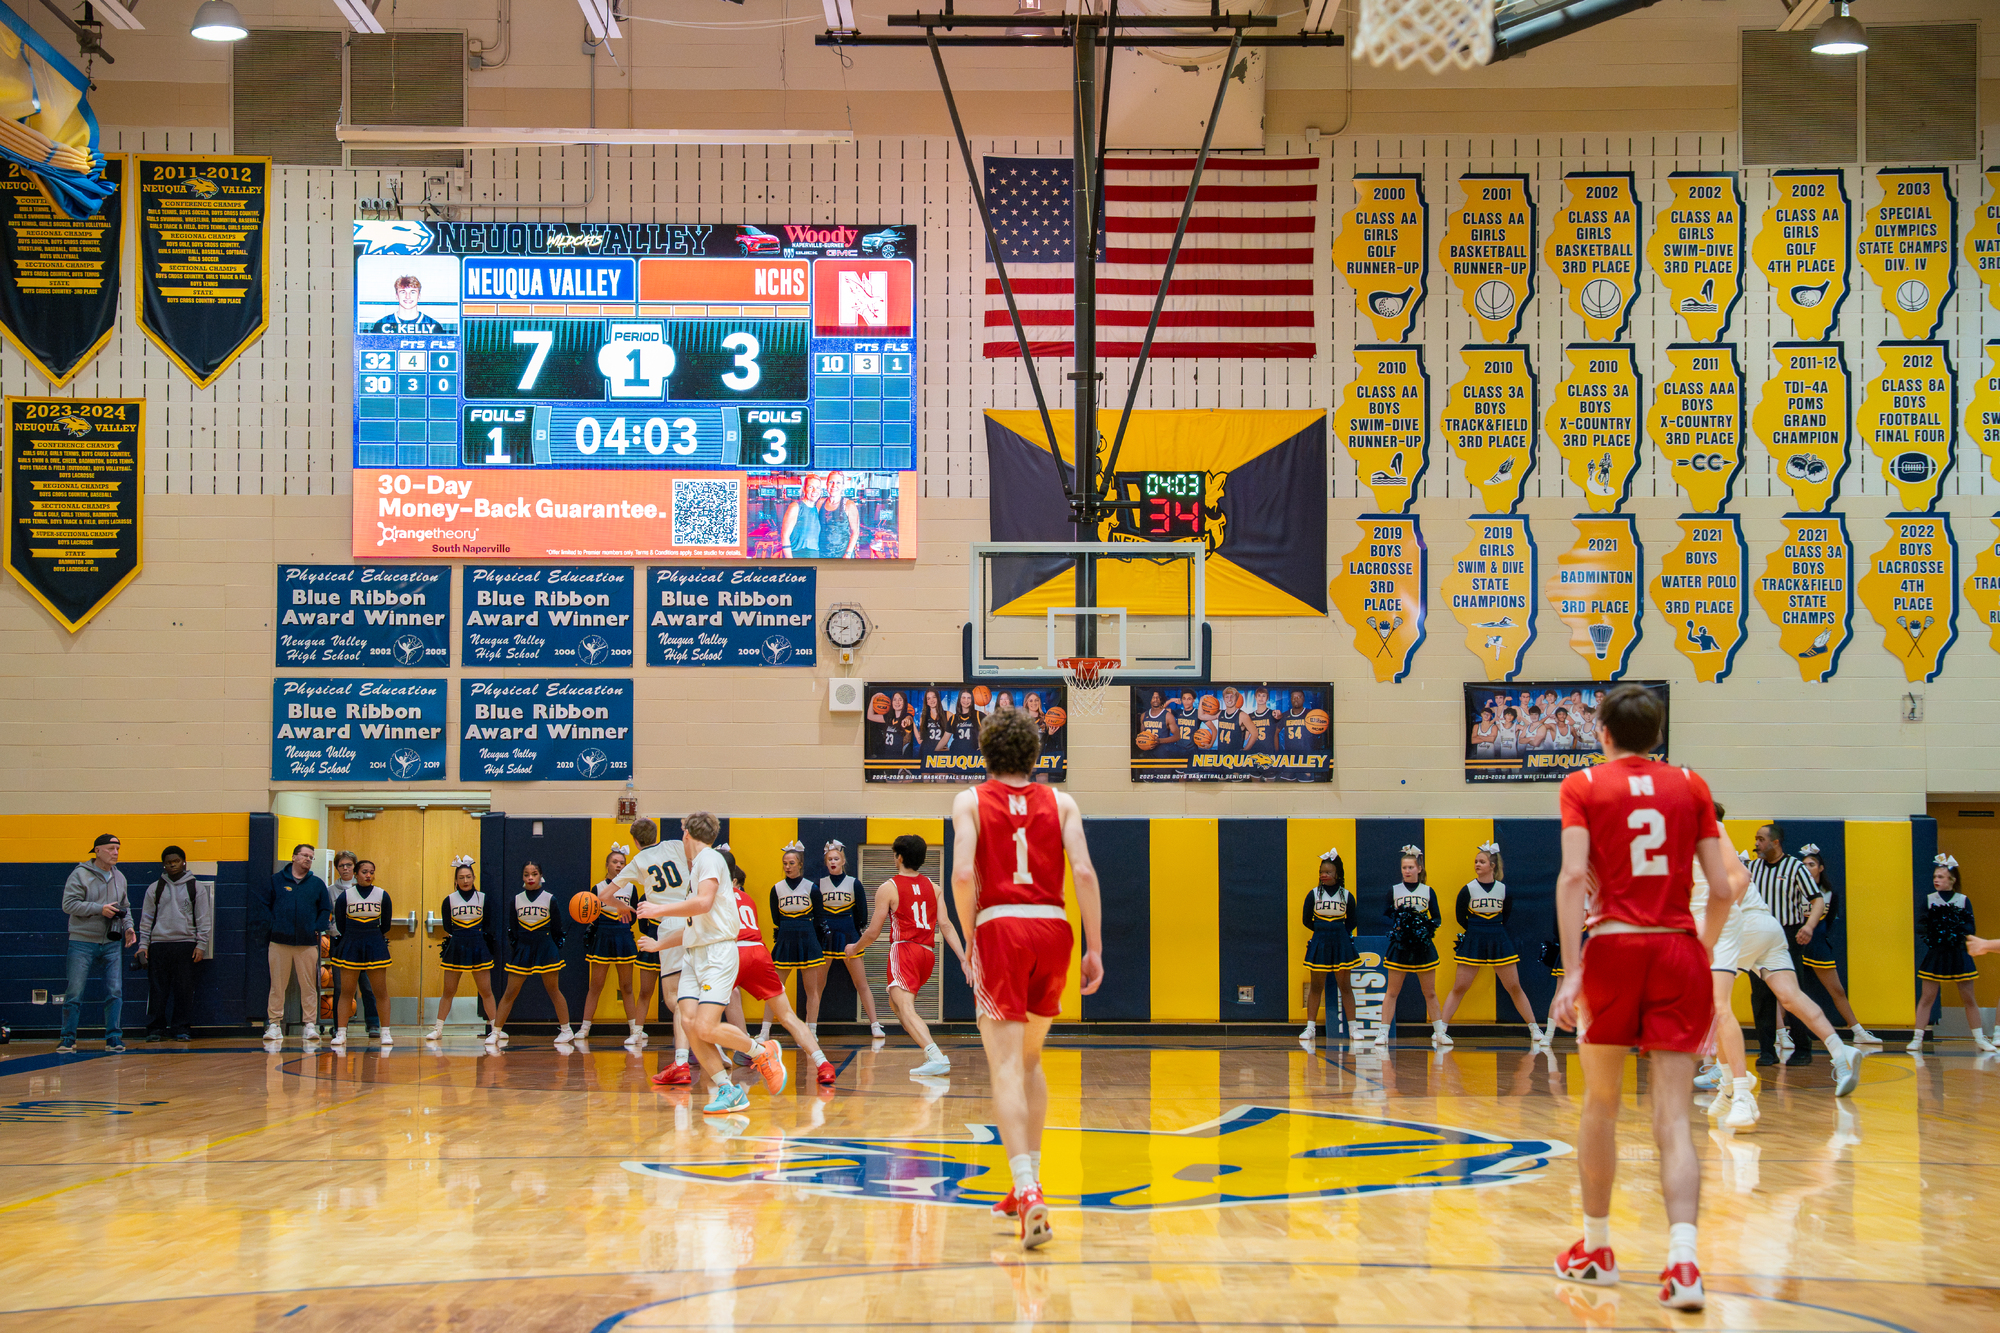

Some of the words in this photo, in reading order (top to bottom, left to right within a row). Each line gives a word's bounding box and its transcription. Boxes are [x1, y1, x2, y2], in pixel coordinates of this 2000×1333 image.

[154, 166, 251, 182] 2011-2012
[143, 185, 187, 194] NEUQUA
[221, 186, 262, 194] VALLEY
[1373, 188, 1405, 200] 2000
[1897, 182, 1930, 195] 2003
[1356, 212, 1395, 225] CLASS
[1401, 212, 1417, 225] AA
[1880, 207, 1932, 220] SPECIAL
[784, 225, 858, 247] Woody
[1364, 228, 1398, 241] GIRLS
[1875, 224, 1937, 237] OLYMPICS
[438, 223, 576, 255] NEUQUA
[580, 223, 712, 255] VALLEY
[547, 233, 603, 247] WILDCATS
[1367, 245, 1396, 258] GOLF
[1859, 241, 1894, 254] STATE
[1899, 240, 1947, 254] CHAMPS
[1347, 261, 1419, 274] RUNNER-UP
[1885, 258, 1909, 271] DIV.
[1915, 258, 1927, 271] IV
[468, 268, 543, 299] NEUQUA
[548, 269, 621, 296] VALLEY
[755, 268, 804, 295] NCHS
[398, 324, 435, 333] KELLY
[615, 332, 659, 341] PERIOD
[400, 341, 425, 350] PTS
[431, 341, 455, 350] FLS
[855, 343, 879, 351] PTS
[884, 343, 909, 351] FLS
[365, 353, 391, 369] 32
[408, 355, 417, 367] 4
[439, 355, 448, 367] 0
[513, 331, 553, 390] 7
[721, 332, 760, 390] 3
[822, 356, 843, 372] 10
[863, 358, 871, 369] 3
[893, 358, 902, 370] 1
[1790, 356, 1836, 369] 2011-12
[624, 349, 649, 386] 1
[365, 376, 391, 392] 30
[408, 379, 418, 391] 3
[439, 379, 448, 391] 0
[1784, 381, 1828, 394] TDI-4A
[1788, 398, 1823, 410] POMS
[26, 405, 125, 420] 2023-2024
[470, 410, 525, 422] FOULS
[748, 411, 801, 423] FOULS
[1783, 414, 1826, 427] GRAND
[15, 423, 60, 432] NEUQUA
[95, 424, 136, 432] VALLEY
[576, 417, 697, 455] 04:03
[1773, 431, 1838, 444] CHAMPION
[486, 428, 510, 463] 1
[762, 429, 786, 464] 3
[378, 475, 472, 499] 30-Day
[1147, 474, 1199, 495] 04:03
[379, 498, 531, 522] Money-Back
[536, 498, 666, 518] Guarantee.
[1150, 498, 1198, 533] 34
[1901, 525, 1934, 538] 2022
[463, 545, 510, 554] Naperville
[1588, 538, 1618, 552] 2021
[1899, 543, 1932, 556] BOYS
[1878, 560, 1944, 574] LACROSSE
[286, 568, 353, 583] Physical
[362, 568, 439, 583] Education
[1561, 570, 1633, 585] BADMINTON
[1901, 580, 1924, 592] 4TH
[293, 589, 341, 605] Blue
[351, 589, 426, 606] Ribbon
[1562, 600, 1585, 614] 3RD
[1591, 600, 1629, 614] PLACE
[1894, 598, 1933, 611] PLACE
[282, 610, 354, 626] Award
[364, 610, 446, 626] Winner
[281, 635, 326, 648] Neuqua
[331, 635, 367, 647] Valley
[287, 650, 319, 662] High
[323, 650, 361, 661] School
[925, 756, 986, 768] NEUQUA
[1193, 754, 1254, 768] NEUQUA
[1272, 754, 1327, 767] VALLEY
[1528, 755, 1590, 769] NEUQUA
[1628, 775, 1655, 796] N
[1008, 794, 1027, 815] N
[1627, 808, 1669, 877] 2
[1012, 827, 1033, 884] 1
[647, 860, 683, 893] 30
[780, 895, 809, 908] CATS
[823, 892, 851, 902] CATS
[1472, 898, 1503, 908] CATS
[348, 903, 381, 913] CATS
[452, 906, 483, 917] CATS
[517, 906, 548, 917] CATS
[1315, 901, 1346, 912] CATS
[911, 901, 931, 930] 11
